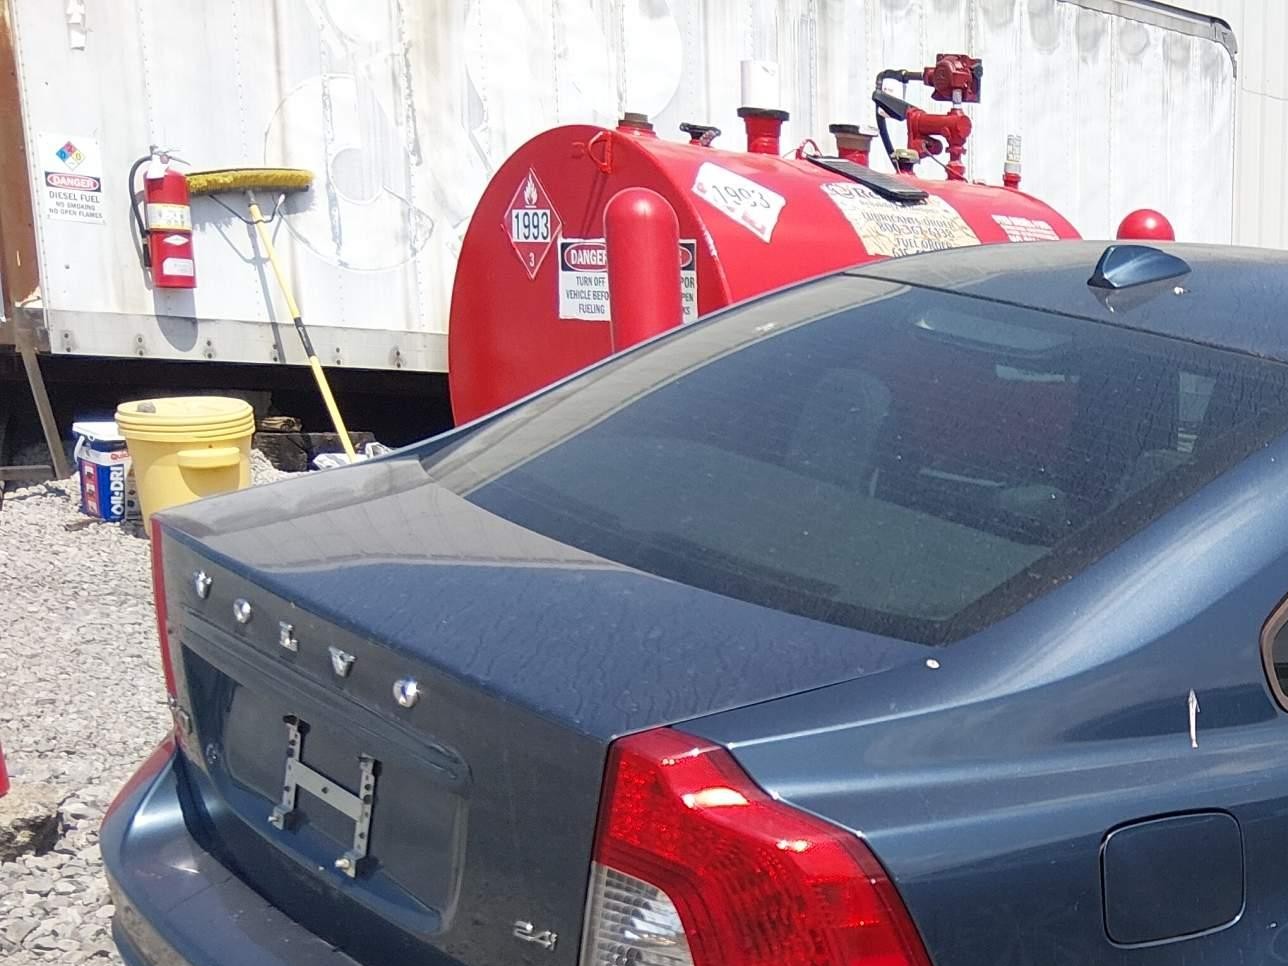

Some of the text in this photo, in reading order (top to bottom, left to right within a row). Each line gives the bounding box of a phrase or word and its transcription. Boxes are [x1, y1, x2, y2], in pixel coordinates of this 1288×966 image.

[52, 174, 94, 188] DANGER
[48, 190, 101, 204] DIESEL FUEL
[55, 200, 96, 211] NO SMOKING
[60, 208, 77, 216] OPEN
[513, 211, 550, 241] 1993
[528, 252, 535, 267] 3
[576, 275, 606, 287] TURN OFF
[680, 276, 695, 288] POR
[566, 289, 609, 301] VEHICLE BEFO
[681, 291, 694, 302] PEN
[578, 303, 606, 315] FUELING
[192, 570, 419, 709] VOLVO
